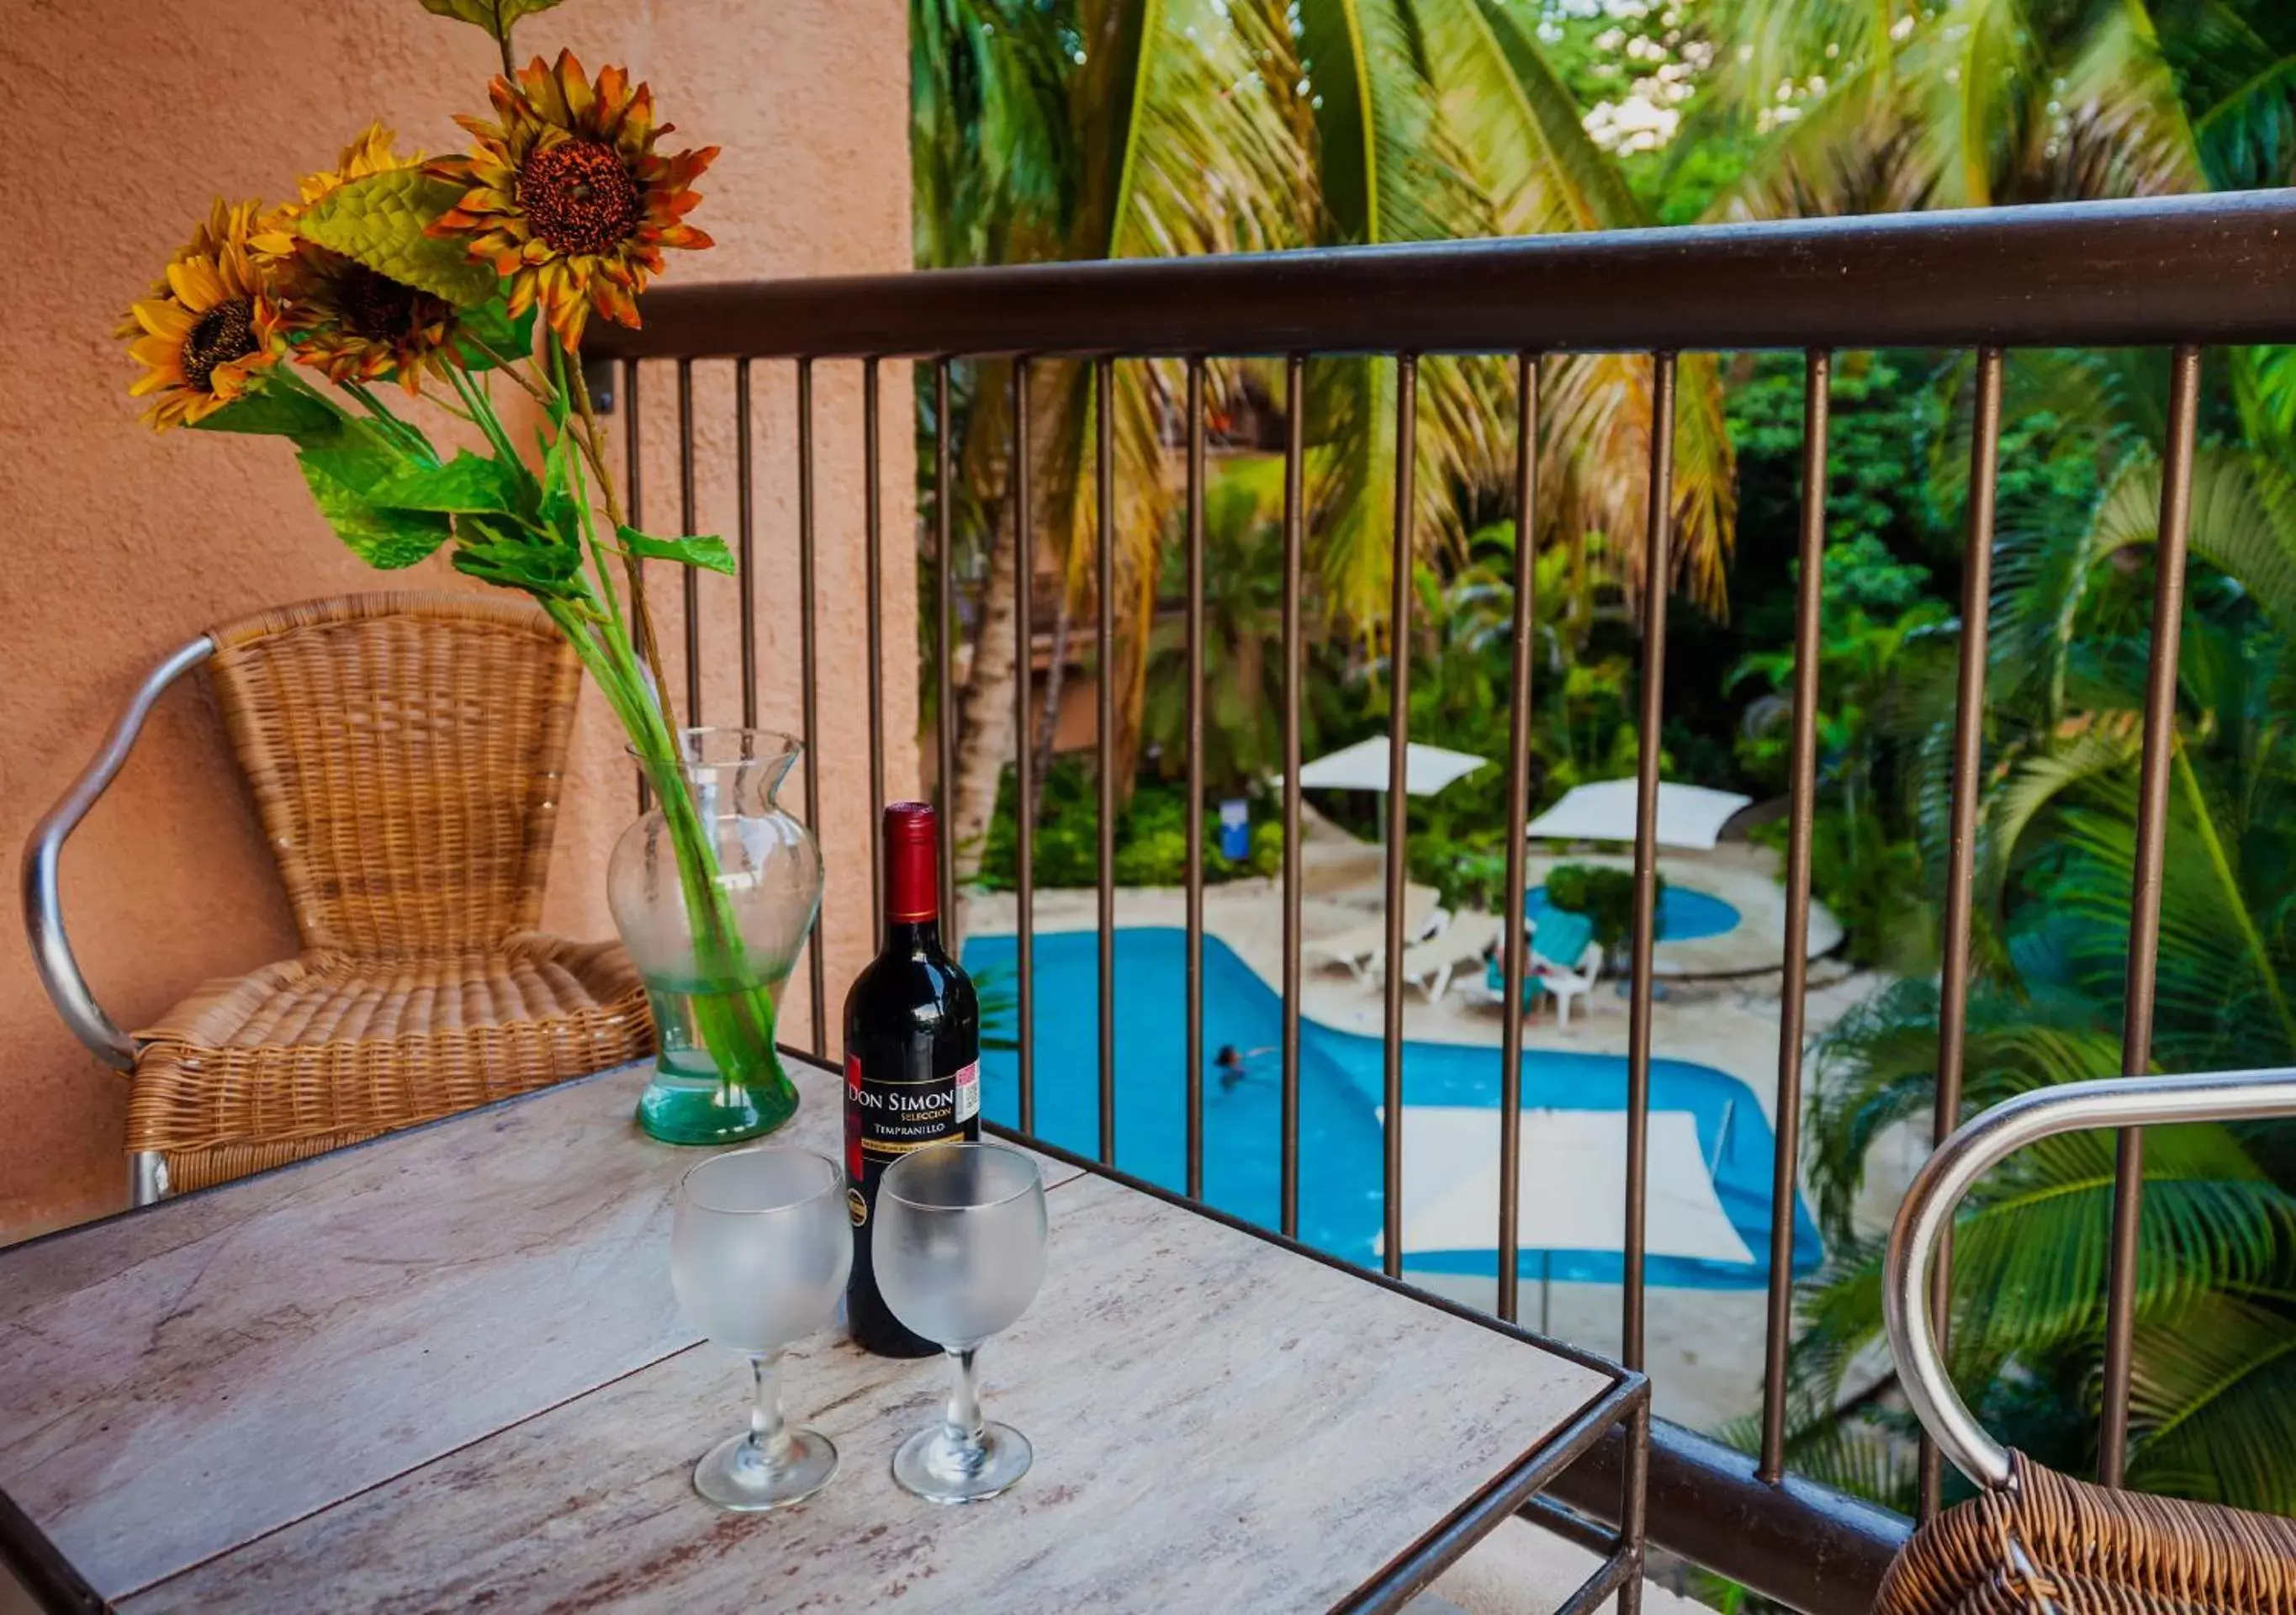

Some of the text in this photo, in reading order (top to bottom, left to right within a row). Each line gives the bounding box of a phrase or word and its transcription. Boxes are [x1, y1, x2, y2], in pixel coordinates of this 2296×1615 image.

[849, 1083, 955, 1111] DON SIMON
[901, 1107, 951, 1121] SELECCION
[875, 1123, 945, 1136] TEMPRANILLO
